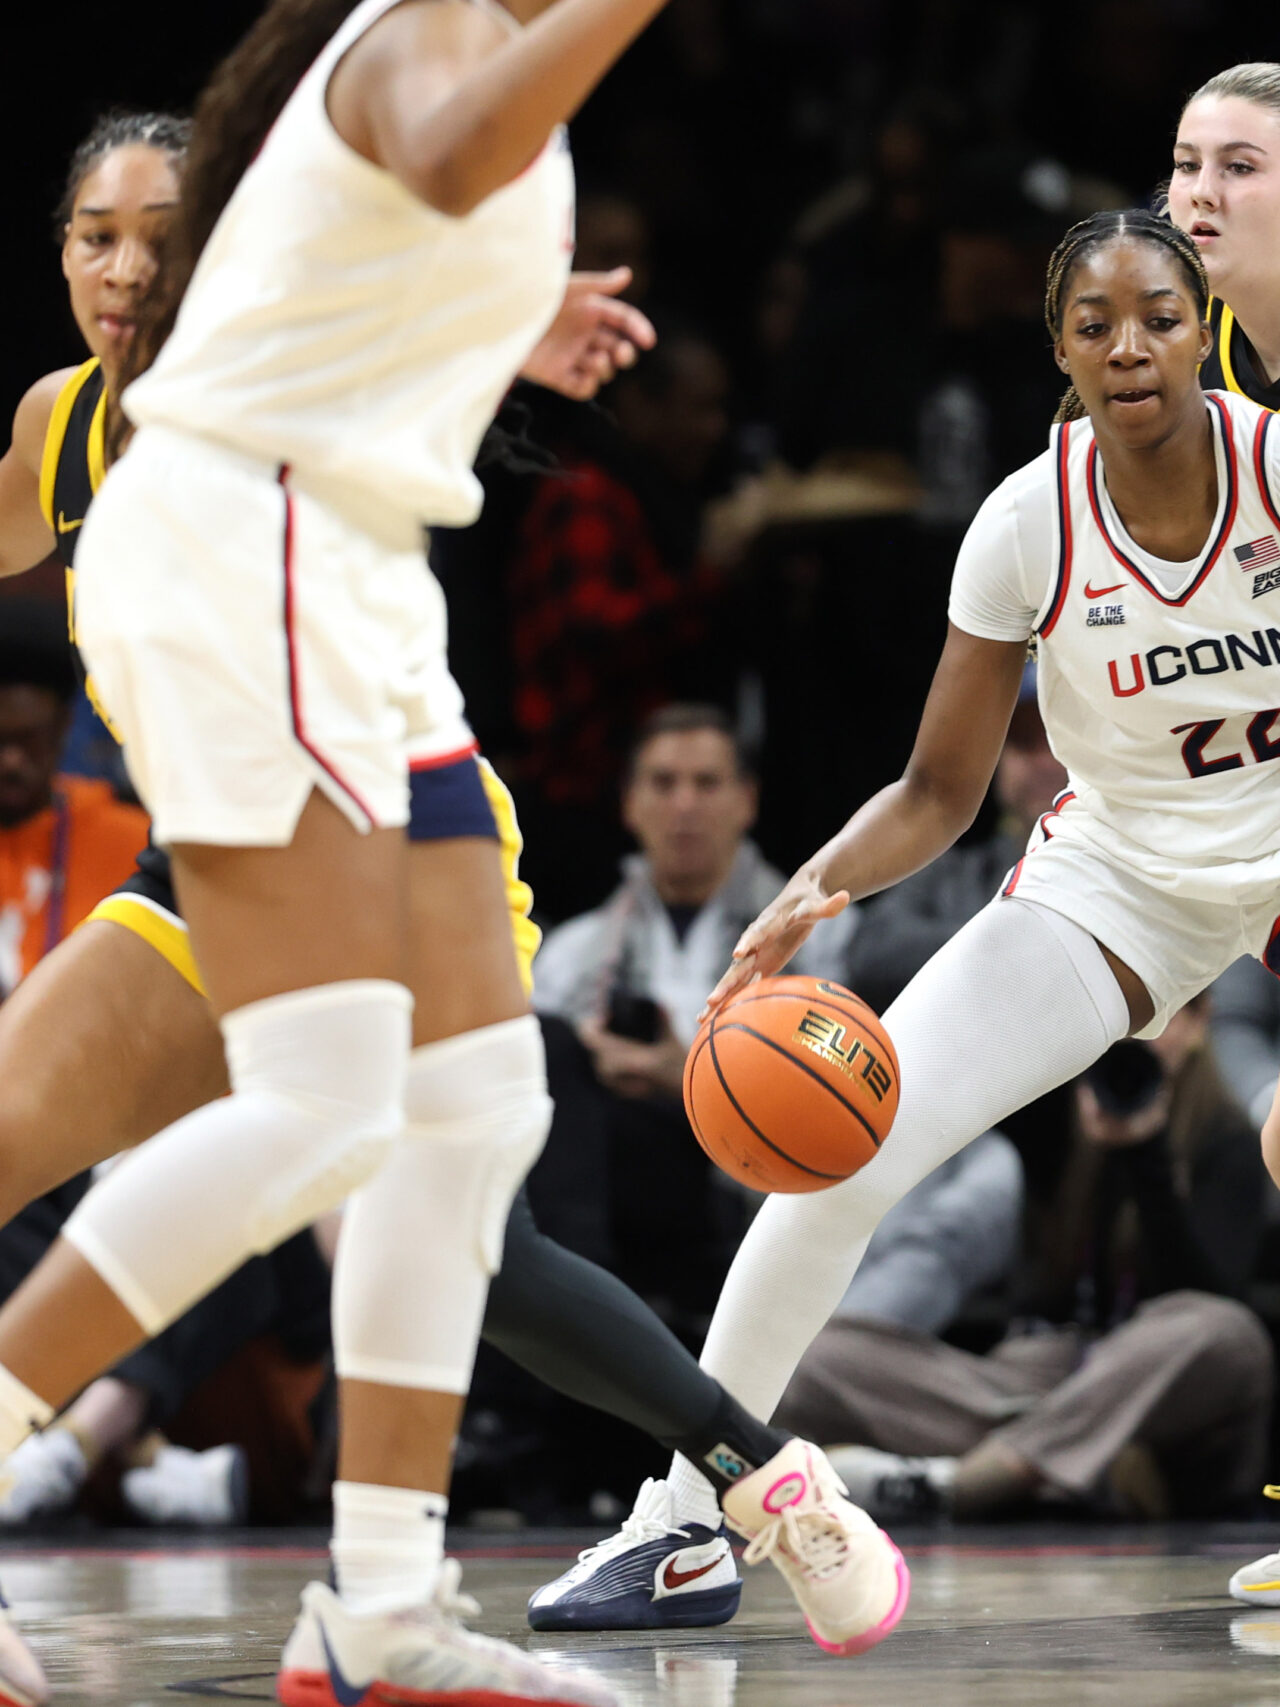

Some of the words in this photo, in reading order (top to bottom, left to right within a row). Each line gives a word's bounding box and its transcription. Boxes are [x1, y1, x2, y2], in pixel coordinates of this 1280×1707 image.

[1088, 606, 1101, 618] BE
[1104, 604, 1124, 616] THE
[1086, 615, 1126, 627] CHANGE
[798, 1008, 892, 1103] ELITE
